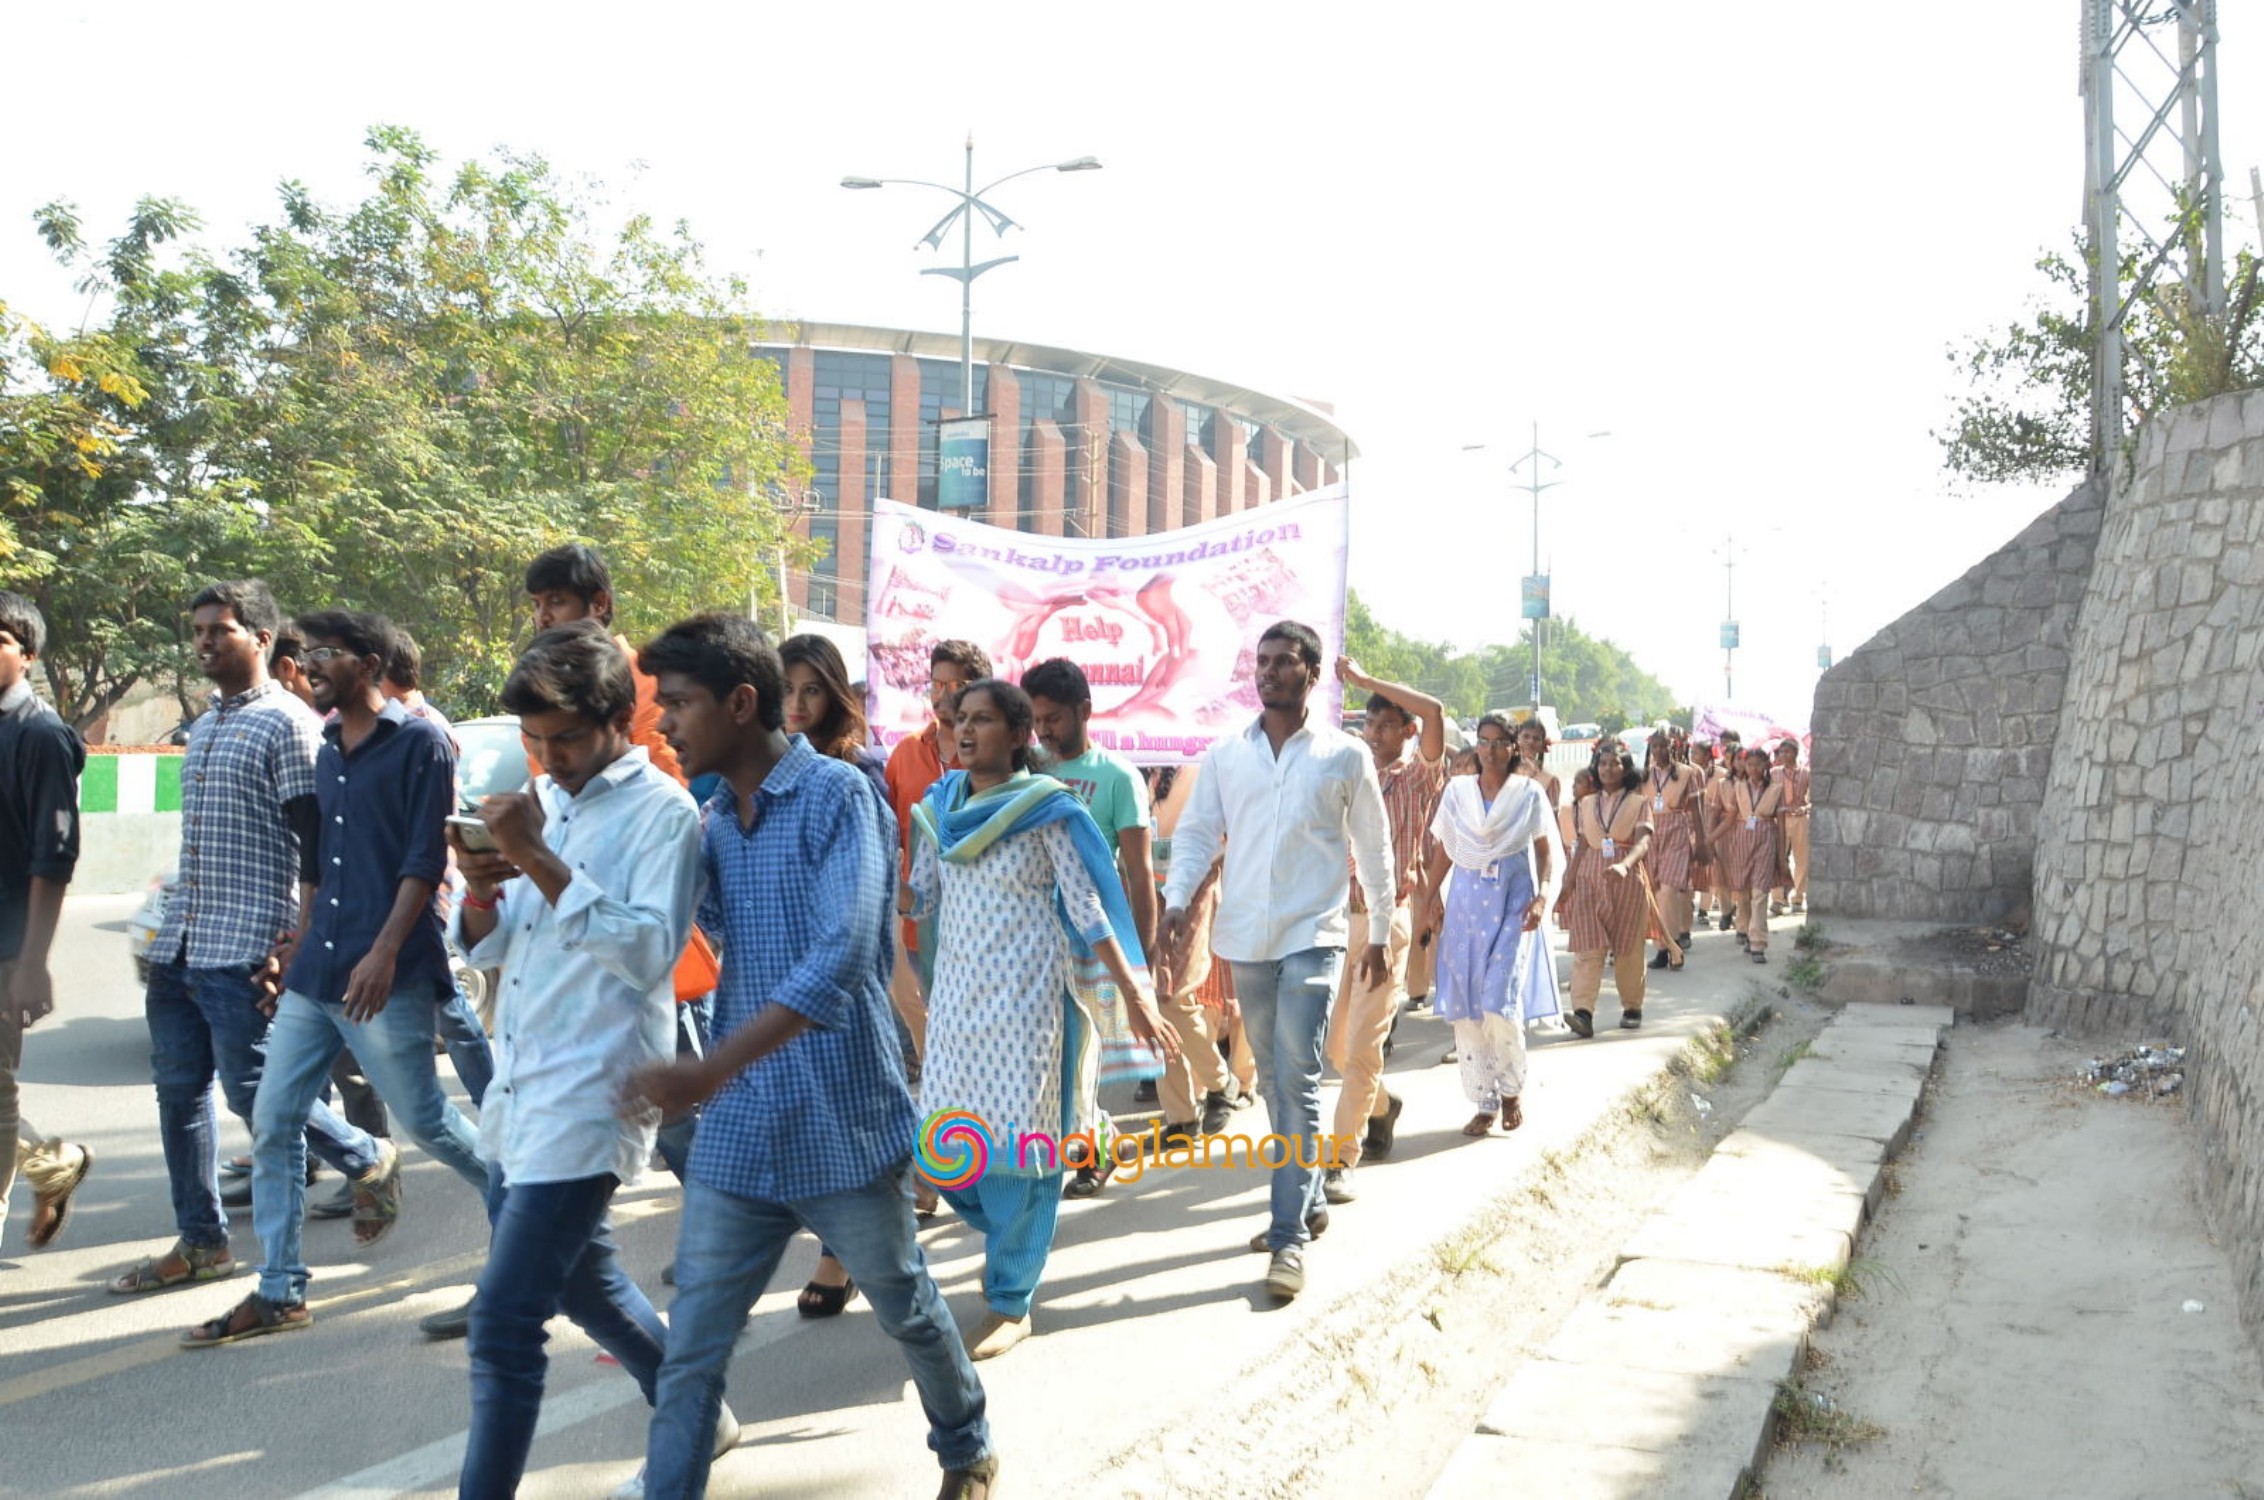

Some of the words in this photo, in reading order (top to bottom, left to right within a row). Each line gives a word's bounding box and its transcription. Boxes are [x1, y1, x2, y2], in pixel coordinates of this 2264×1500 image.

[973, 466, 986, 477] be
[932, 532, 1085, 576] Sankalp
[1091, 521, 1302, 572] Foundation
[1058, 615, 1123, 649] Help
[1120, 735, 1134, 750] a
